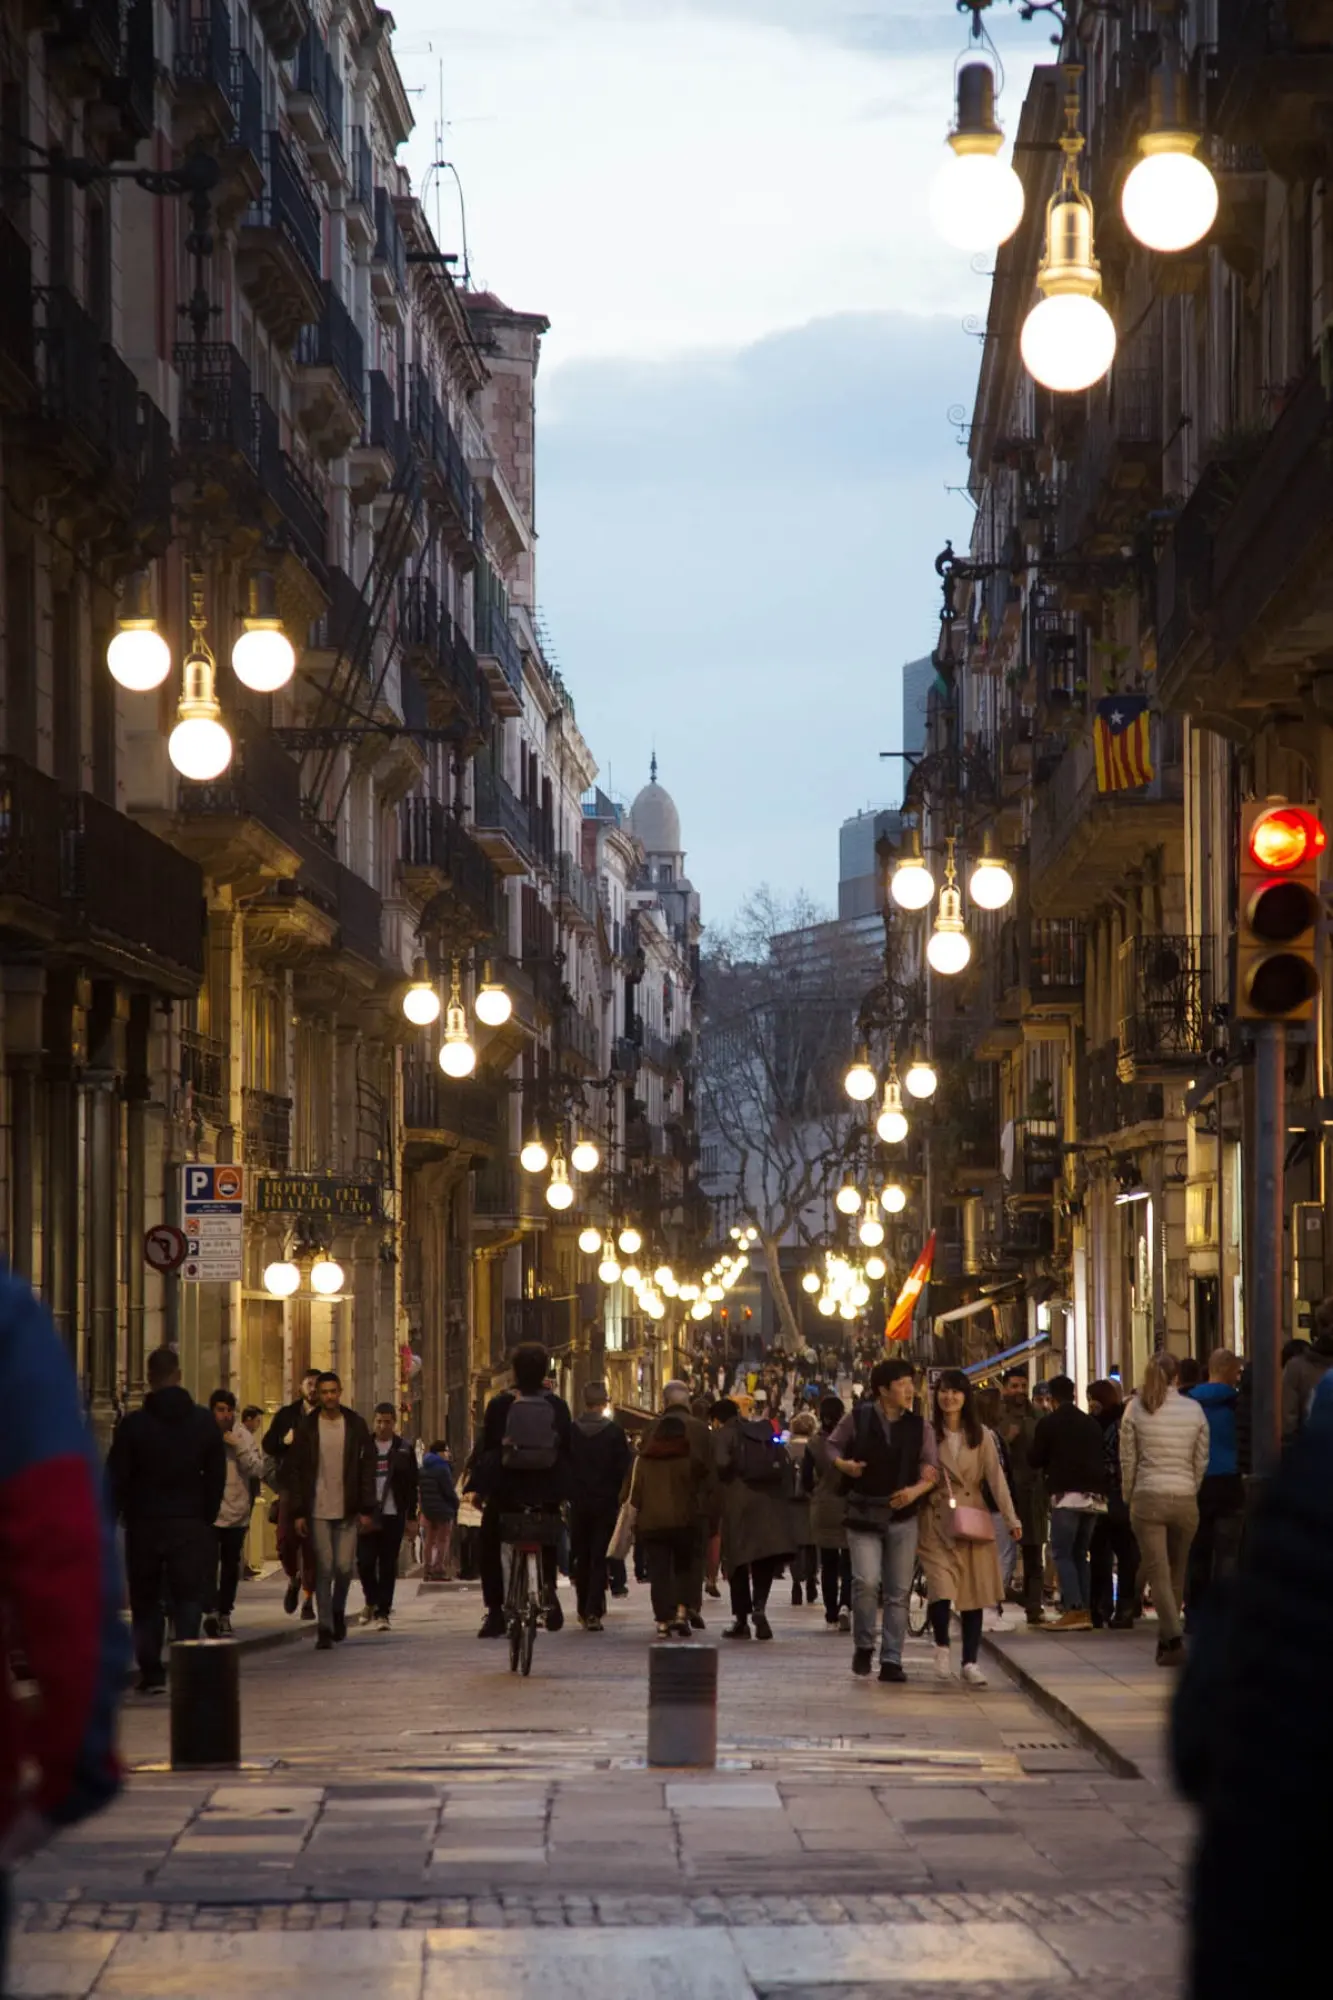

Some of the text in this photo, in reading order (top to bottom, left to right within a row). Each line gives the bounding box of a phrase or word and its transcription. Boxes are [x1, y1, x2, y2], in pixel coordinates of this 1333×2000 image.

[192, 1171, 208, 1196] P
[265, 1181, 319, 1195] HOTEL
[264, 1196, 332, 1209] RIALTO
[188, 1241, 197, 1254] P
